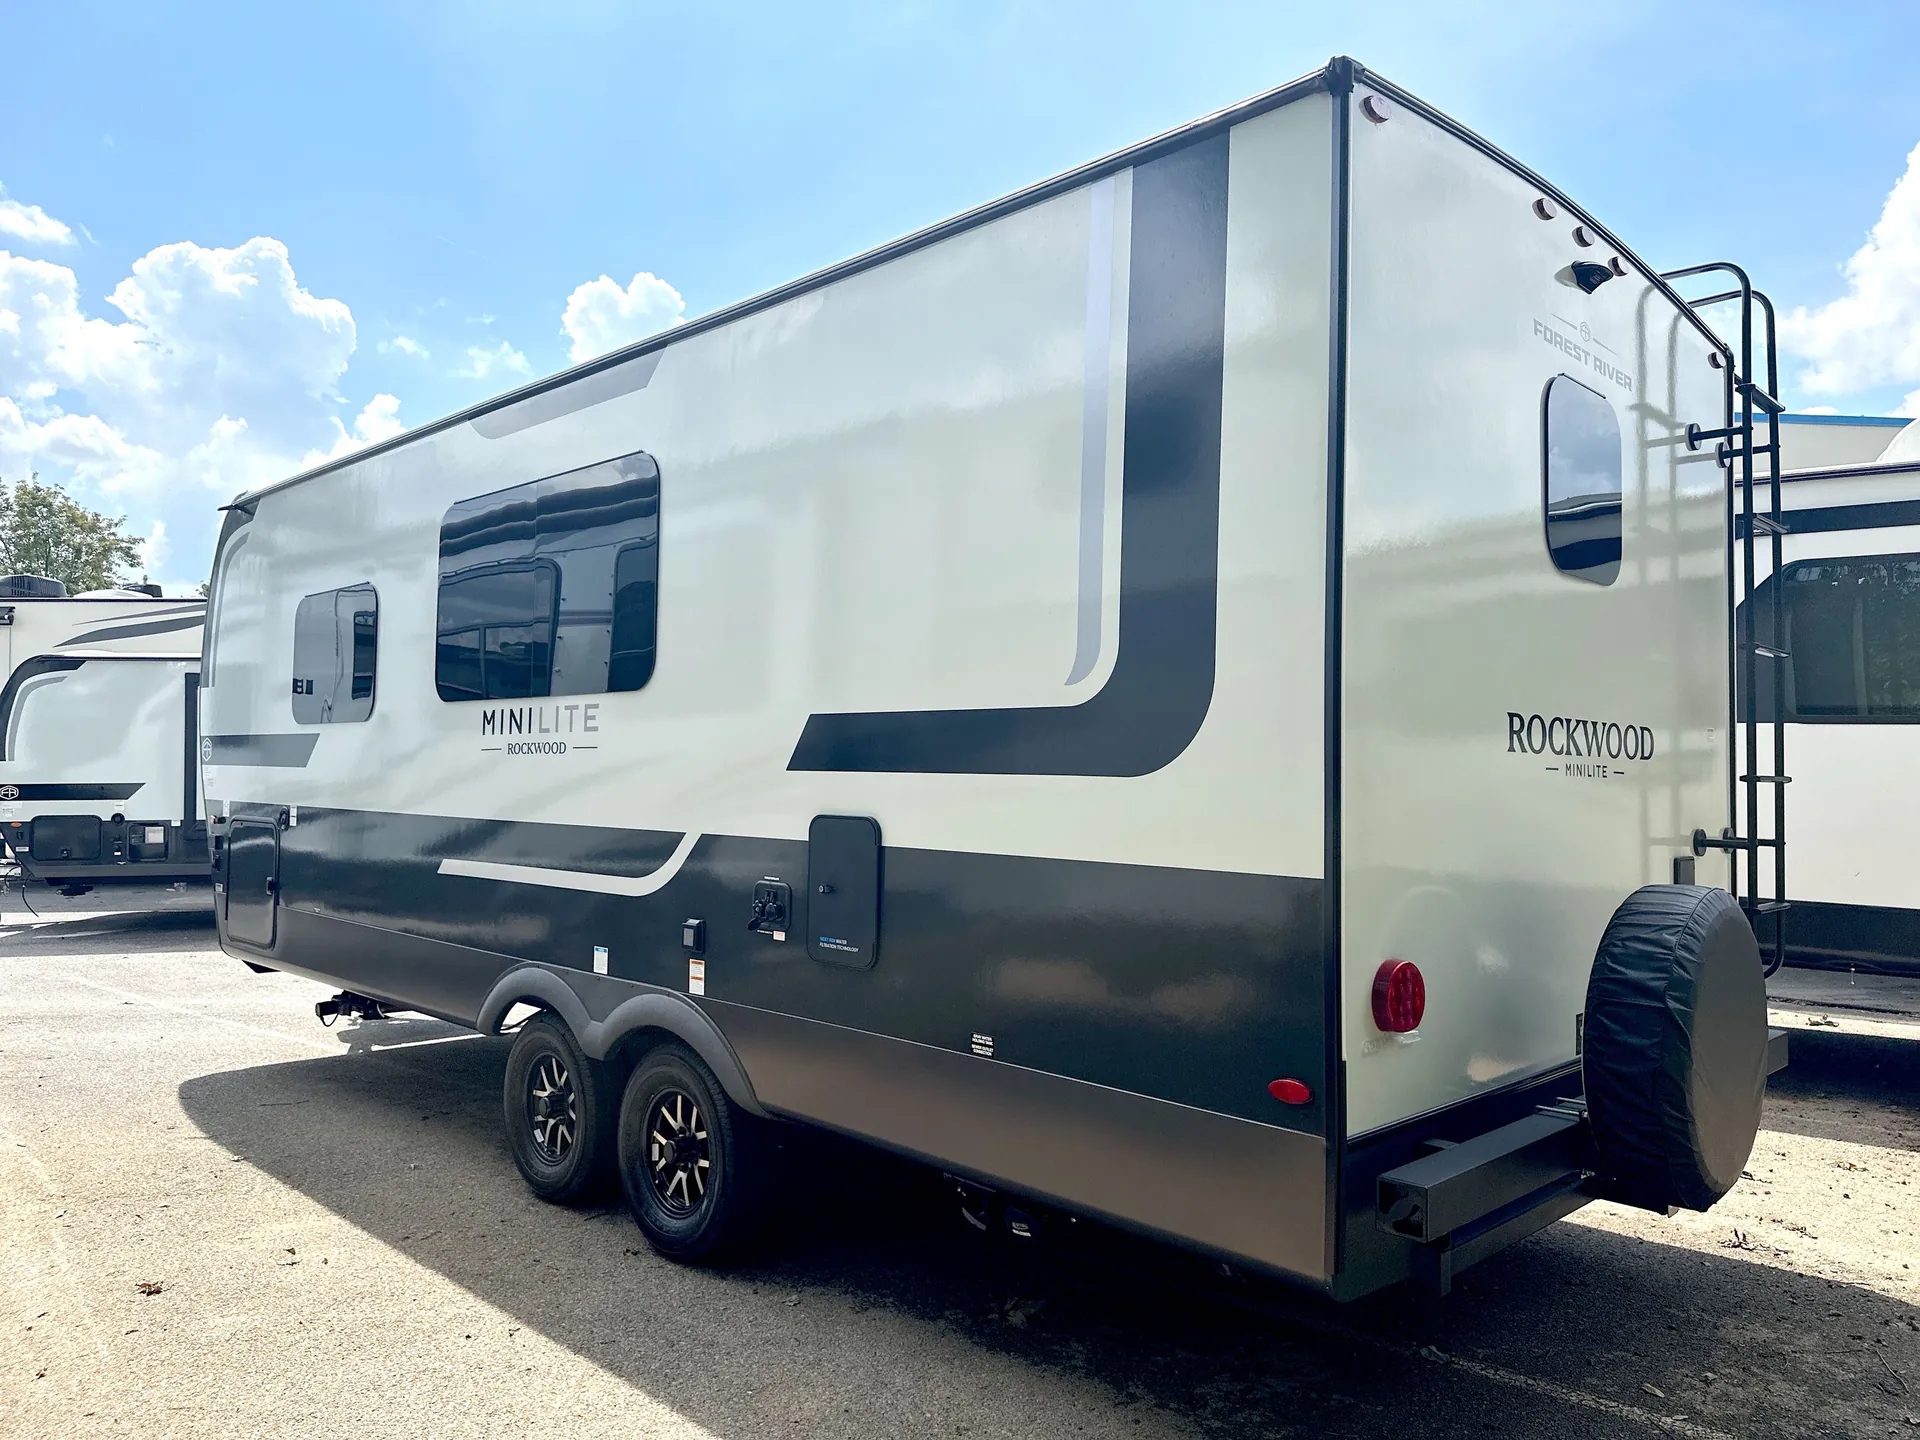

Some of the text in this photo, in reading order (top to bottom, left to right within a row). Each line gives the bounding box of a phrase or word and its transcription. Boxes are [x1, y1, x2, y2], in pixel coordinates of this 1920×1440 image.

[1533, 318, 1591, 367] FOREST
[1593, 354, 1633, 392] RIVER
[482, 703, 600, 736] MINILITE
[1506, 711, 1655, 761] ROCKWOOD
[507, 741, 567, 755] ROCKWOOD
[1565, 763, 1608, 778] MINILITE
